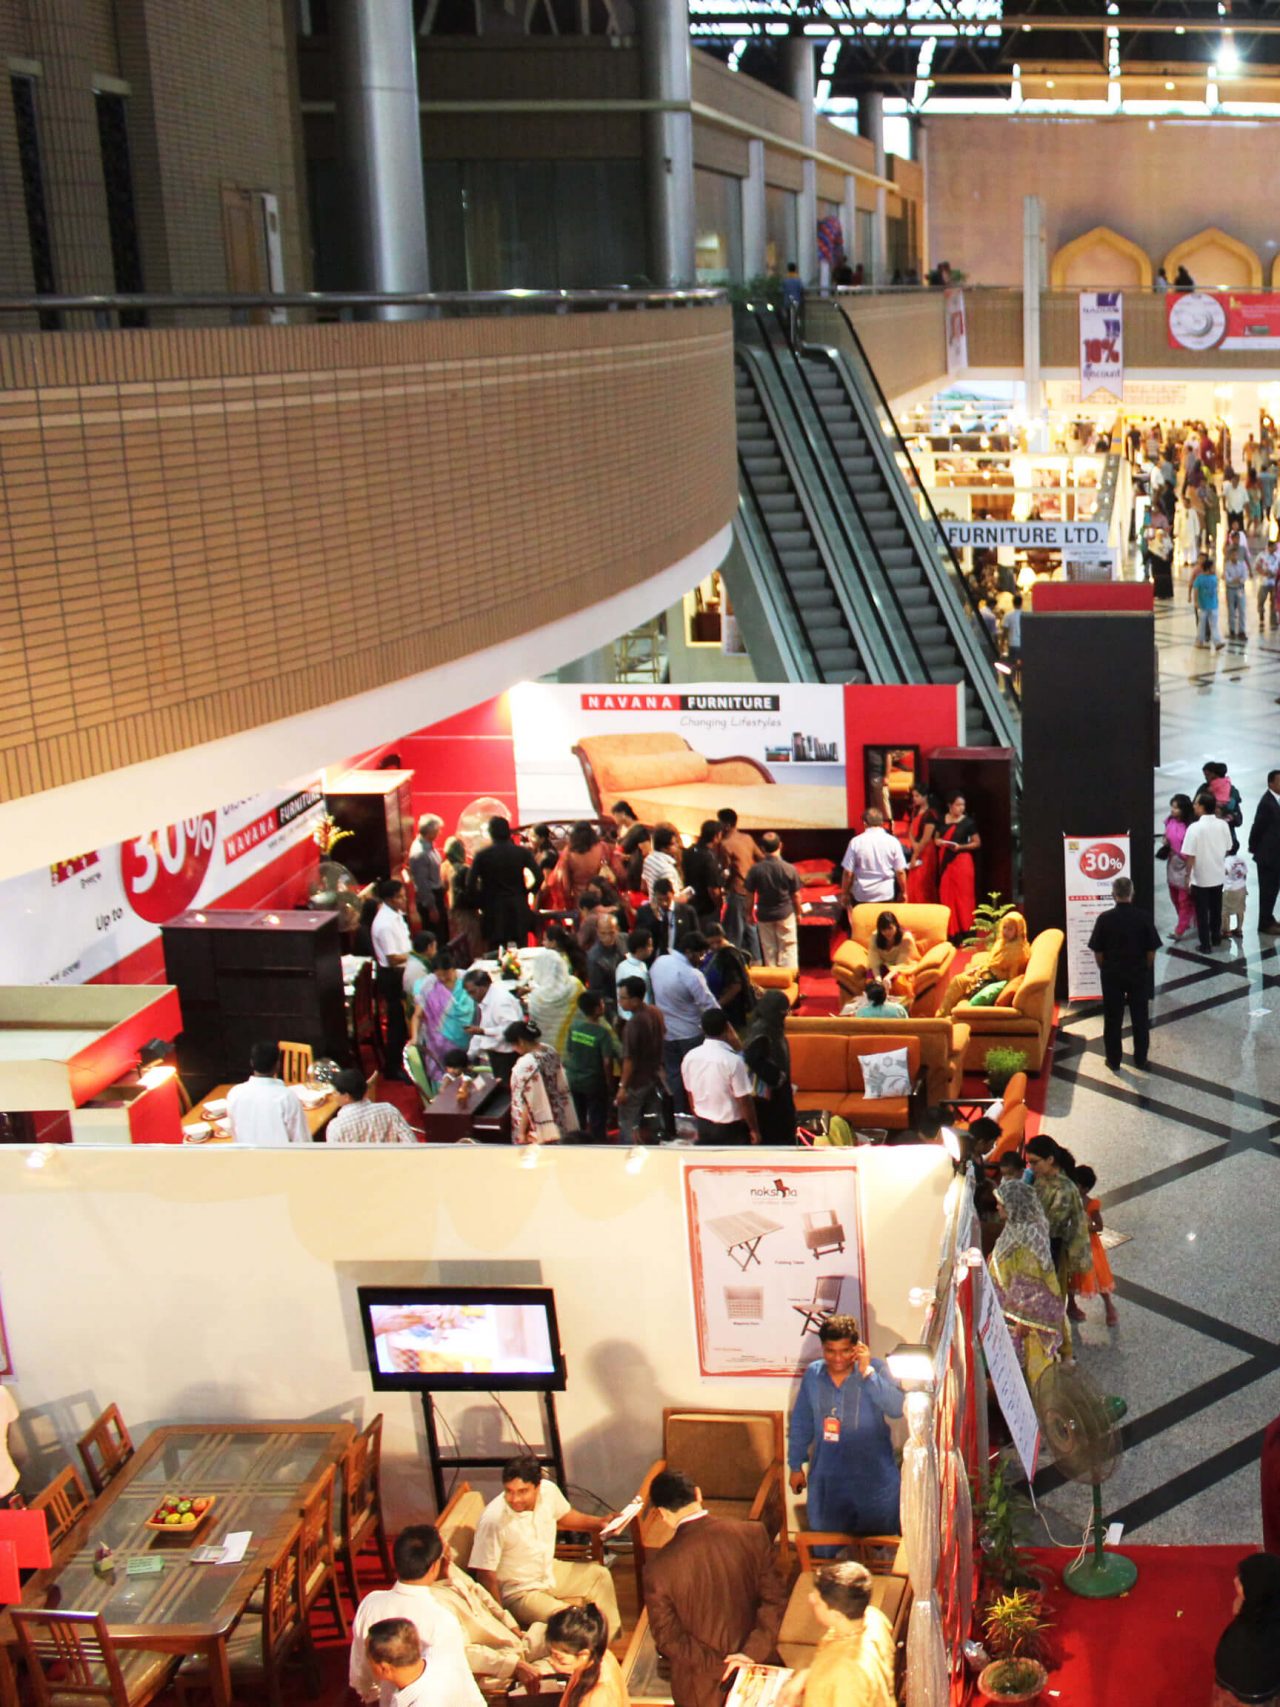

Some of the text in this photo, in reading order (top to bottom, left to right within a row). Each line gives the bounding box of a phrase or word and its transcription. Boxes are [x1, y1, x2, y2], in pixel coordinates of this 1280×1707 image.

[1083, 338, 1120, 363] 10%
[949, 527, 1057, 544] FURNITURE
[1064, 527, 1105, 544] LTD.
[588, 696, 772, 709] NAVANA FURNITURE
[680, 715, 782, 728] Changing Lifestyles
[227, 816, 275, 858] NAVANA
[1085, 852, 1123, 871] 30%
[96, 907, 123, 931] Up to
